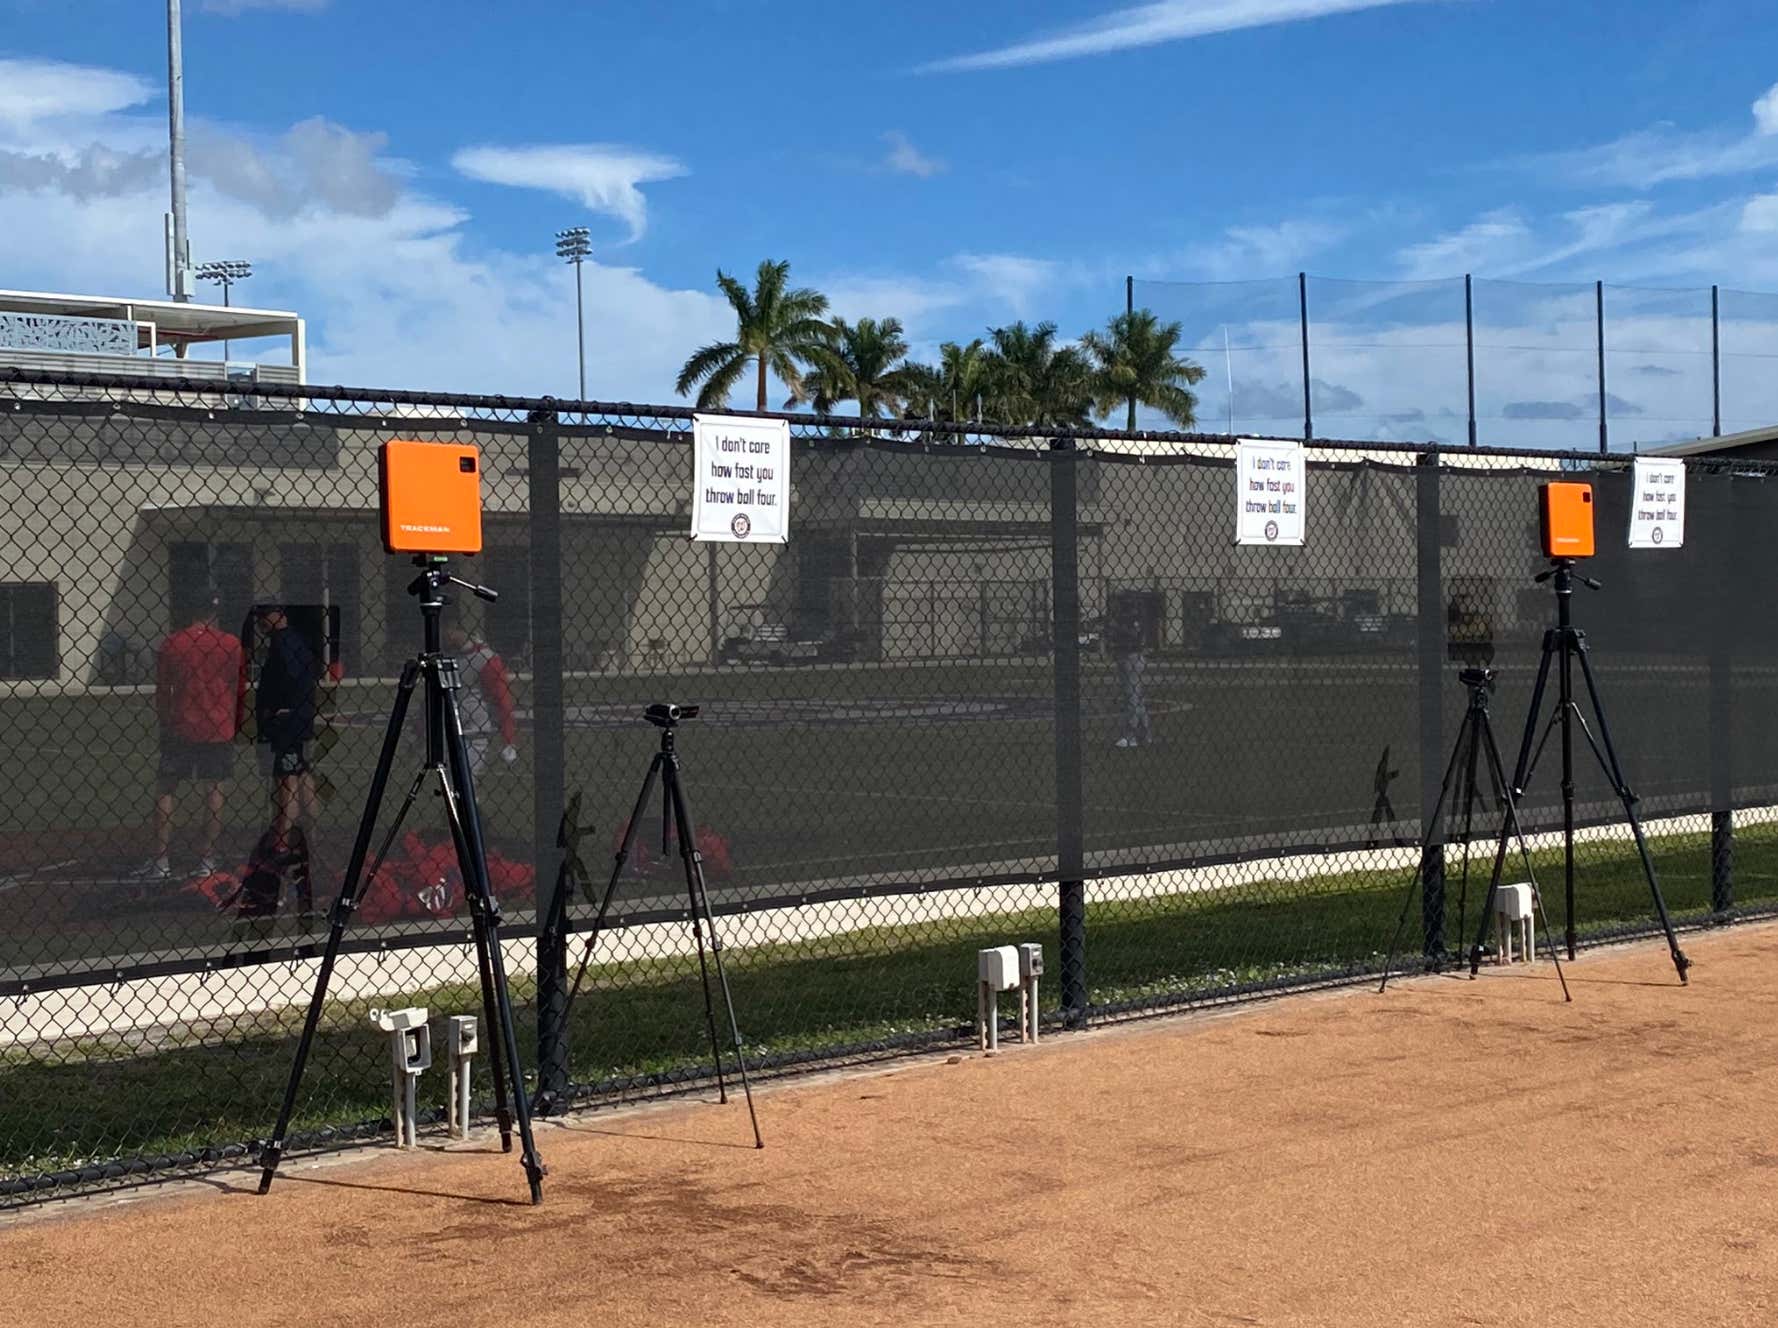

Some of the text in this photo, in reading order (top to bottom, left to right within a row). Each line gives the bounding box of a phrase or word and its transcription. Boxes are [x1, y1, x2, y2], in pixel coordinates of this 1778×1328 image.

[721, 434, 746, 453] don't
[748, 439, 771, 455] care
[711, 460, 774, 484] how fast you
[1257, 456, 1275, 471] don't
[1276, 460, 1292, 471] care
[1249, 477, 1295, 495] how fast you
[705, 486, 778, 506] throw ball four.
[1245, 498, 1266, 513] throw
[1268, 499, 1281, 514] ball
